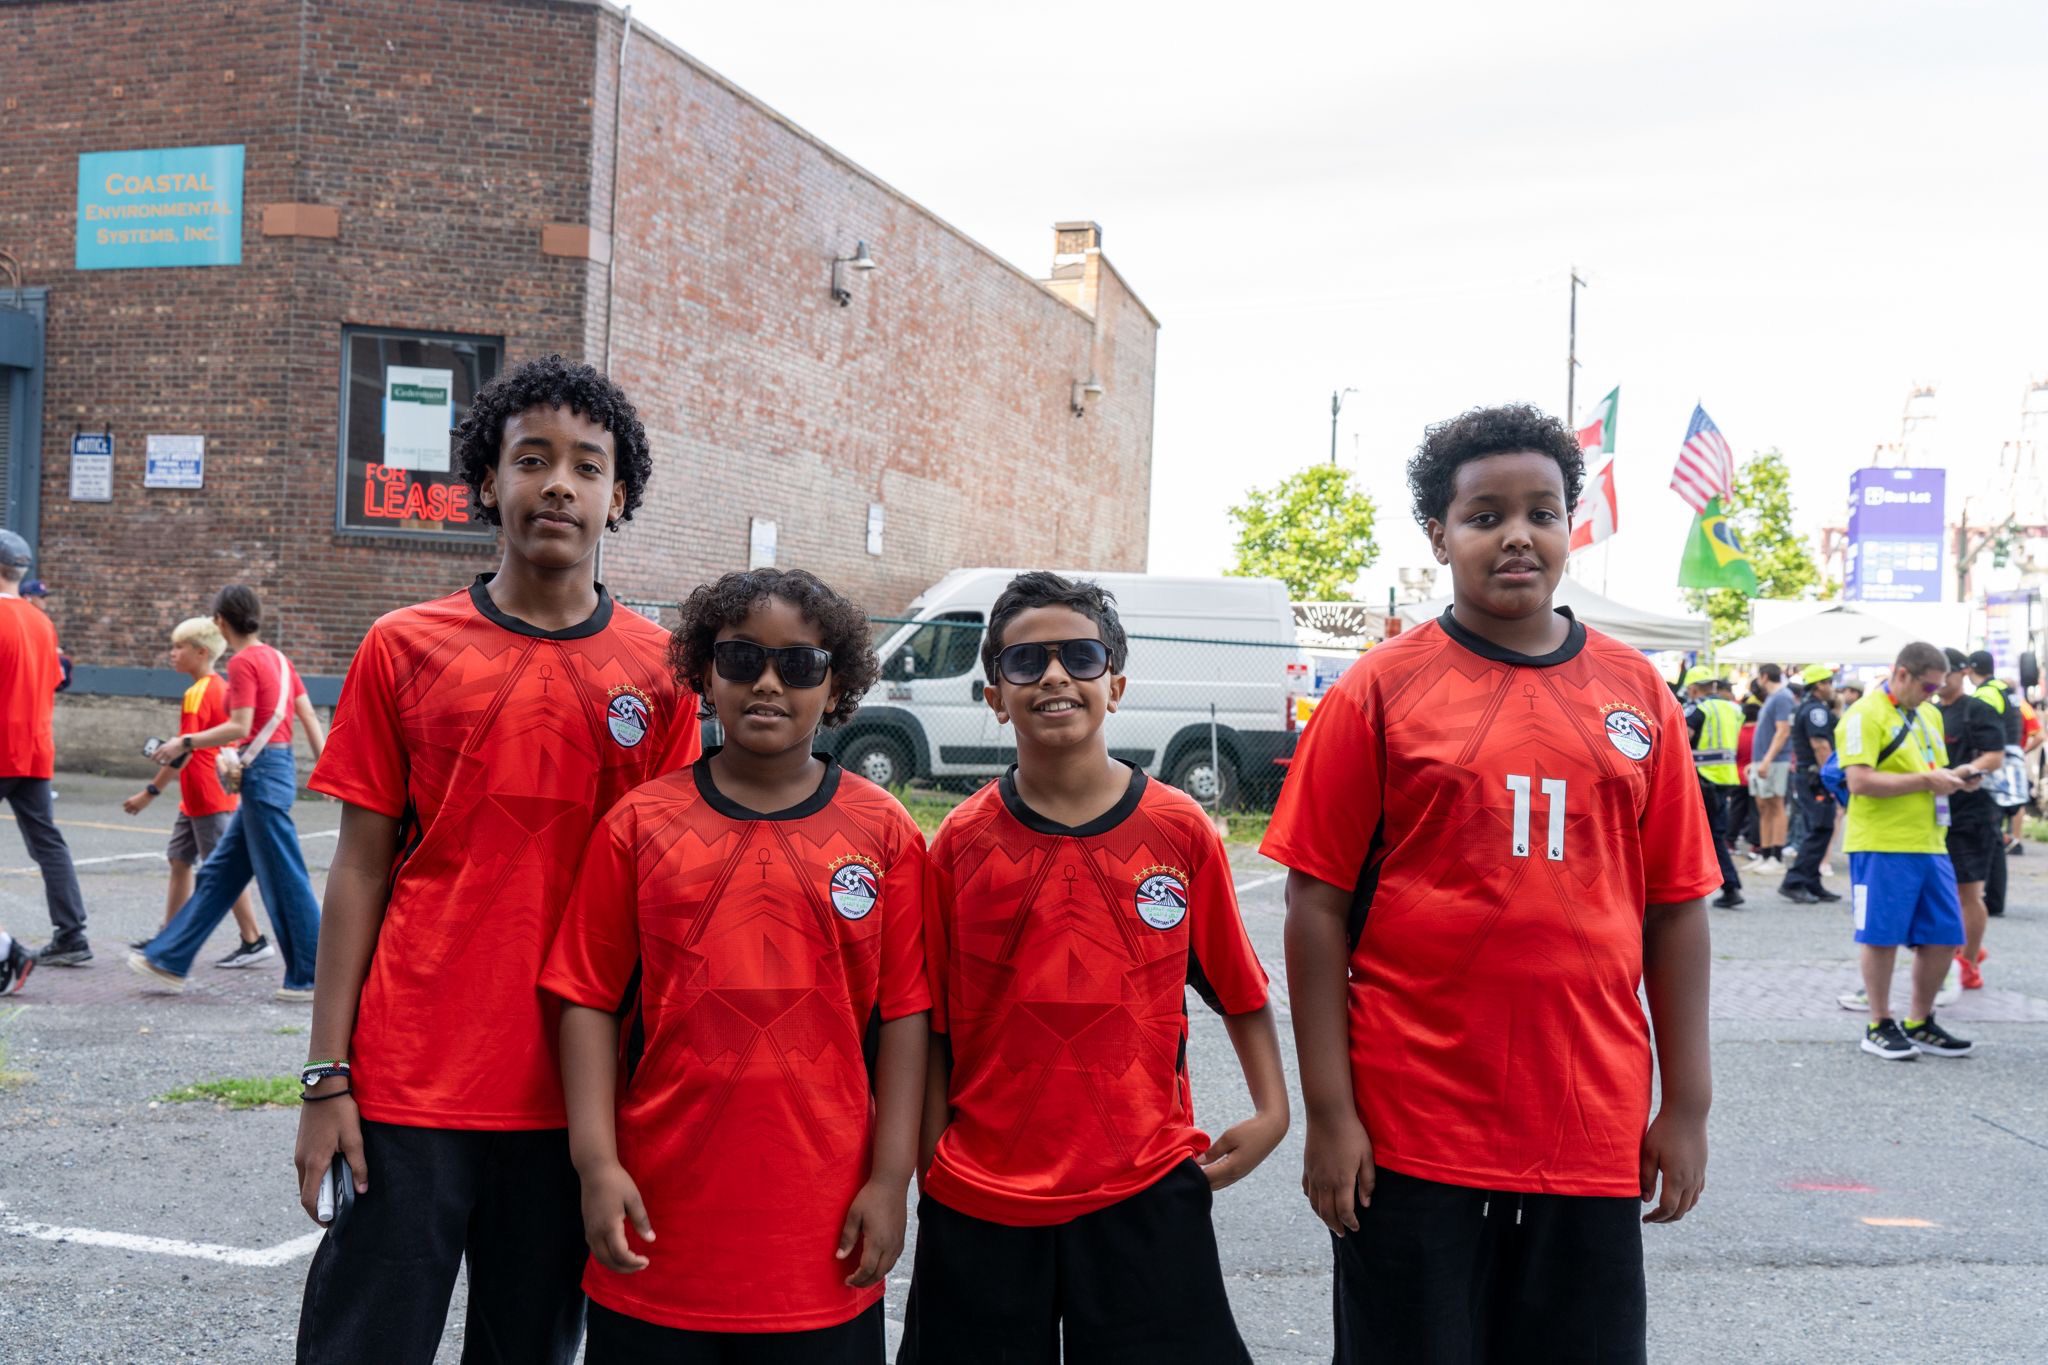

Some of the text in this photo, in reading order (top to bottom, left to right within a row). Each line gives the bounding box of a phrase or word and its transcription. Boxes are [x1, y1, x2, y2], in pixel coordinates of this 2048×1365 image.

[105, 173, 215, 196] COASTAL
[85, 199, 233, 221] ENVIRONMENTAL
[366, 463, 406, 481] FOR
[364, 480, 469, 522] LEASE
[1506, 774, 1567, 861] 11
